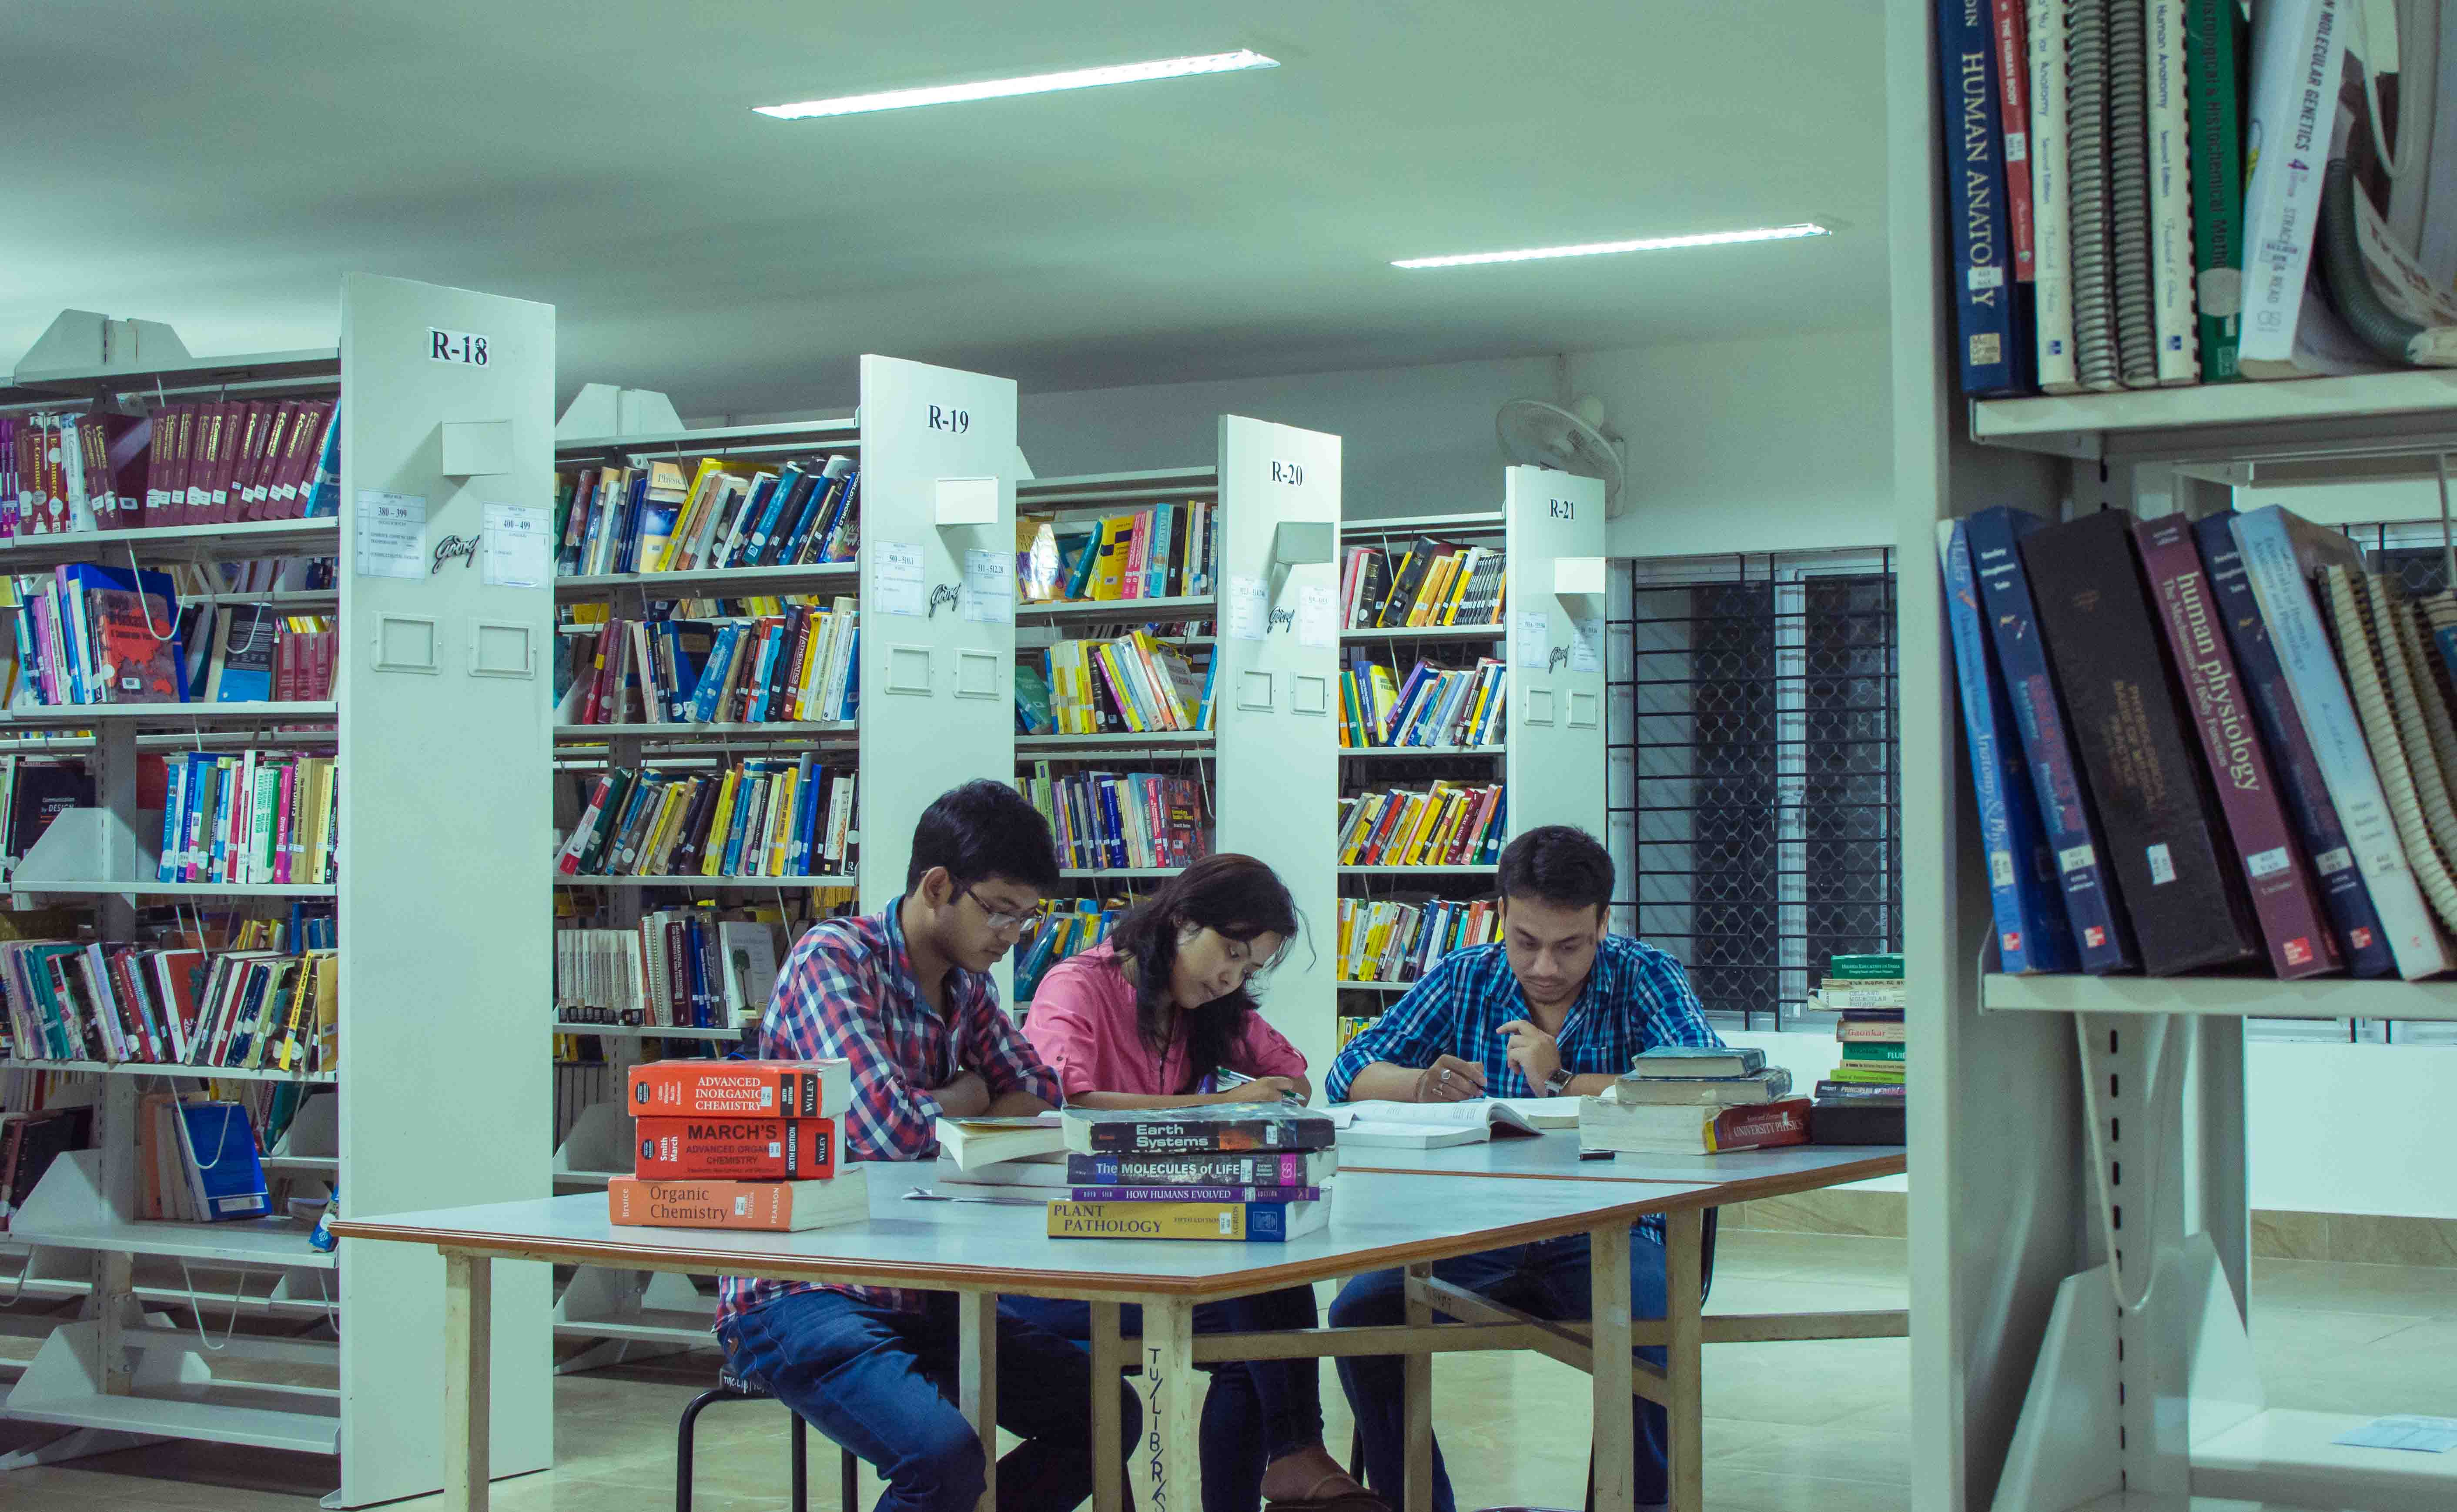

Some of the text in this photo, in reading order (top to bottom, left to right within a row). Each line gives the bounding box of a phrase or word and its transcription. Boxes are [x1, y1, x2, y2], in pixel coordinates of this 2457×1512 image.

[2202, 0, 2219, 88] istological
[2002, 18, 2017, 106] THE HUMAN BODY
[2156, 6, 2169, 110] Human Anatomy
[2039, 62, 2049, 117] Anatomy
[2294, 11, 2335, 152] MOLECULAR GENETICS
[2202, 100, 2226, 213] Histochemical
[2287, 159, 2310, 172] 4
[1962, 51, 1995, 308] HUMAN ANATOY
[2211, 217, 2228, 268] Metho
[431, 329, 488, 366] R-18
[929, 405, 969, 434] R-19
[243, 413, 257, 459] E-Commerce
[288, 413, 306, 459] E-Commerce
[1272, 461, 1302, 487] R-20
[378, 507, 407, 518] 380 399
[838, 500, 851, 527] WORLD
[1550, 498, 1574, 520] R-21
[503, 519, 530, 530] 400 499
[791, 621, 810, 686] MATHEMATICS
[2176, 571, 2260, 791] human physiology
[164, 803, 173, 842] MOVIES
[696, 1088, 762, 1099] INORGANIC
[698, 1077, 760, 1087] ADVANCED
[696, 1101, 762, 1111] CHEMISTRY
[806, 1079, 814, 1112] WILEY
[687, 1124, 777, 1140] MARCH'S
[1136, 1124, 1184, 1135] Earth
[1733, 1121, 1775, 1137] UNIVERSITY
[686, 1144, 769, 1154] ADVANCED ORGAN
[1136, 1136, 1208, 1148] Systems
[706, 1156, 758, 1165] CHEMISTRY
[1096, 1162, 1239, 1174] The MOLECULES of LIFE
[650, 1186, 710, 1202] Organic
[771, 1188, 780, 1224] PEARSON
[1126, 1190, 1231, 1199] HOW HUMANS EVOLVED
[650, 1203, 728, 1221] Chemistry
[1054, 1204, 1104, 1217] PLANT
[1064, 1219, 1162, 1233] PATHOLOGY
